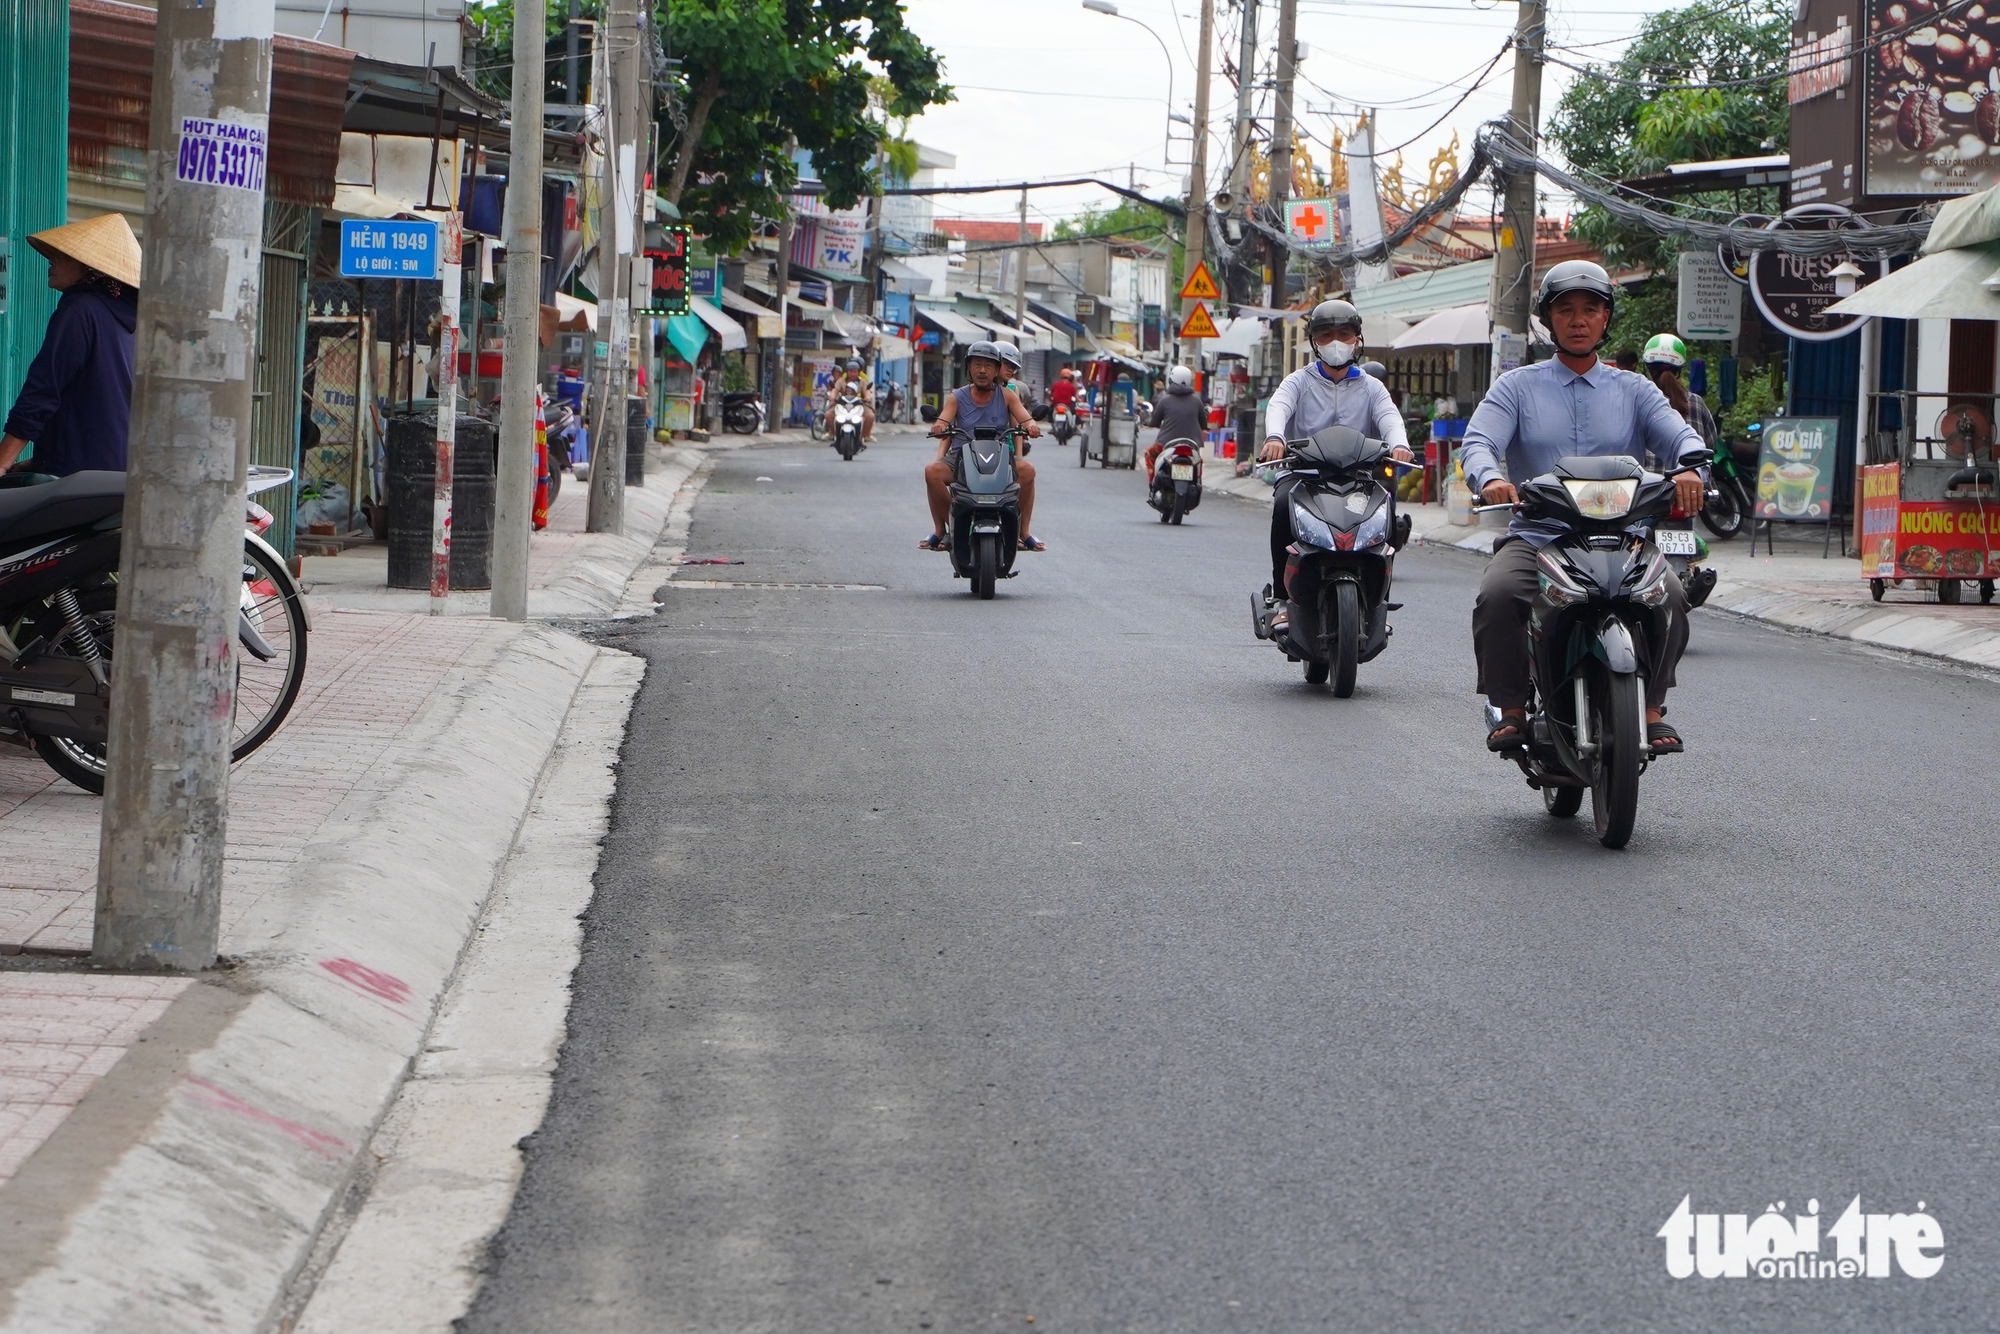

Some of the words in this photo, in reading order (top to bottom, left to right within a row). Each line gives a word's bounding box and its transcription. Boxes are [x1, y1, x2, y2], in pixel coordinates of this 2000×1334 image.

[350, 224, 386, 249] HẺM
[391, 232, 428, 250] 1949
[355, 255, 368, 272] LỘ
[371, 255, 392, 270] GIỚI
[402, 259, 418, 271] 5M
[825, 248, 852, 264] 7K
[1799, 427, 1823, 450] GIÀ
[1901, 507, 1954, 534] NƯỚNG
[1958, 508, 1986, 534] CÁC
[1661, 532, 1690, 542] 59-C3
[1659, 542, 1694, 553] 067.16
[0, 544, 79, 574] FUTURE
